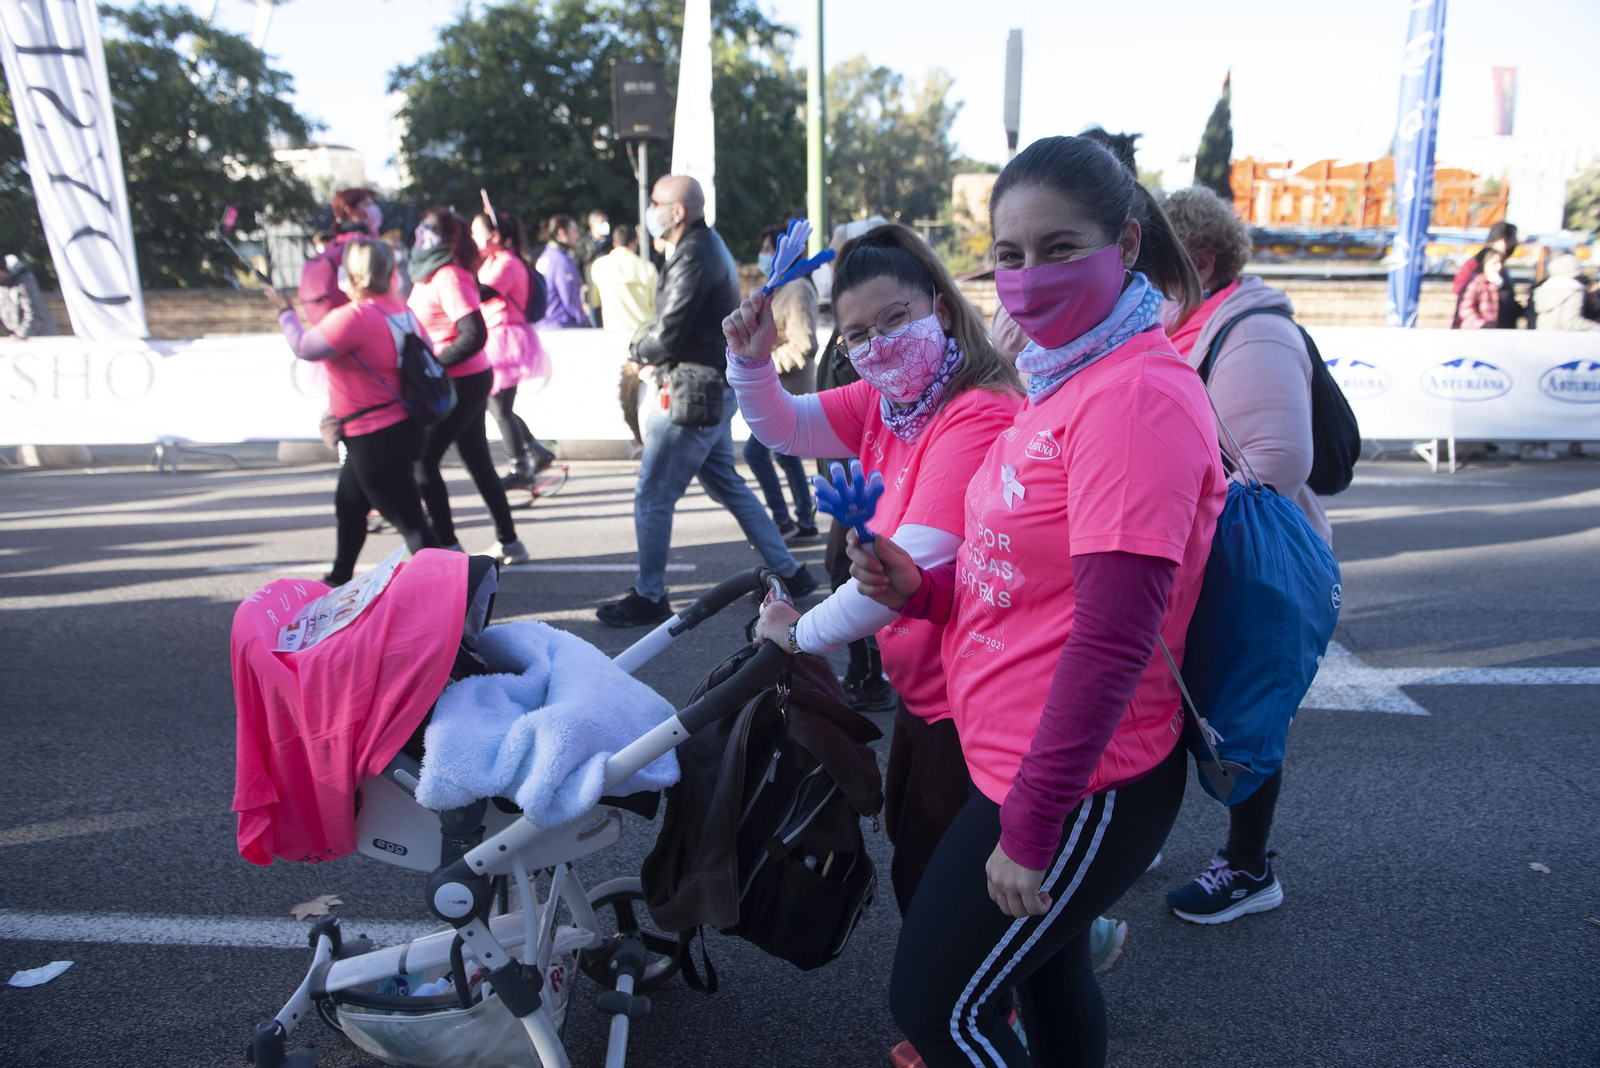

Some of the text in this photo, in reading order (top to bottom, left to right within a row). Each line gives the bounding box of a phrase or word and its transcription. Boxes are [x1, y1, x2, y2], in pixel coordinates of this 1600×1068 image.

[0, 348, 156, 402] SHO
[978, 523, 1011, 553] POR
[267, 582, 308, 626] RUN
[986, 637, 1005, 651] 2021
[375, 839, 406, 855] egg
